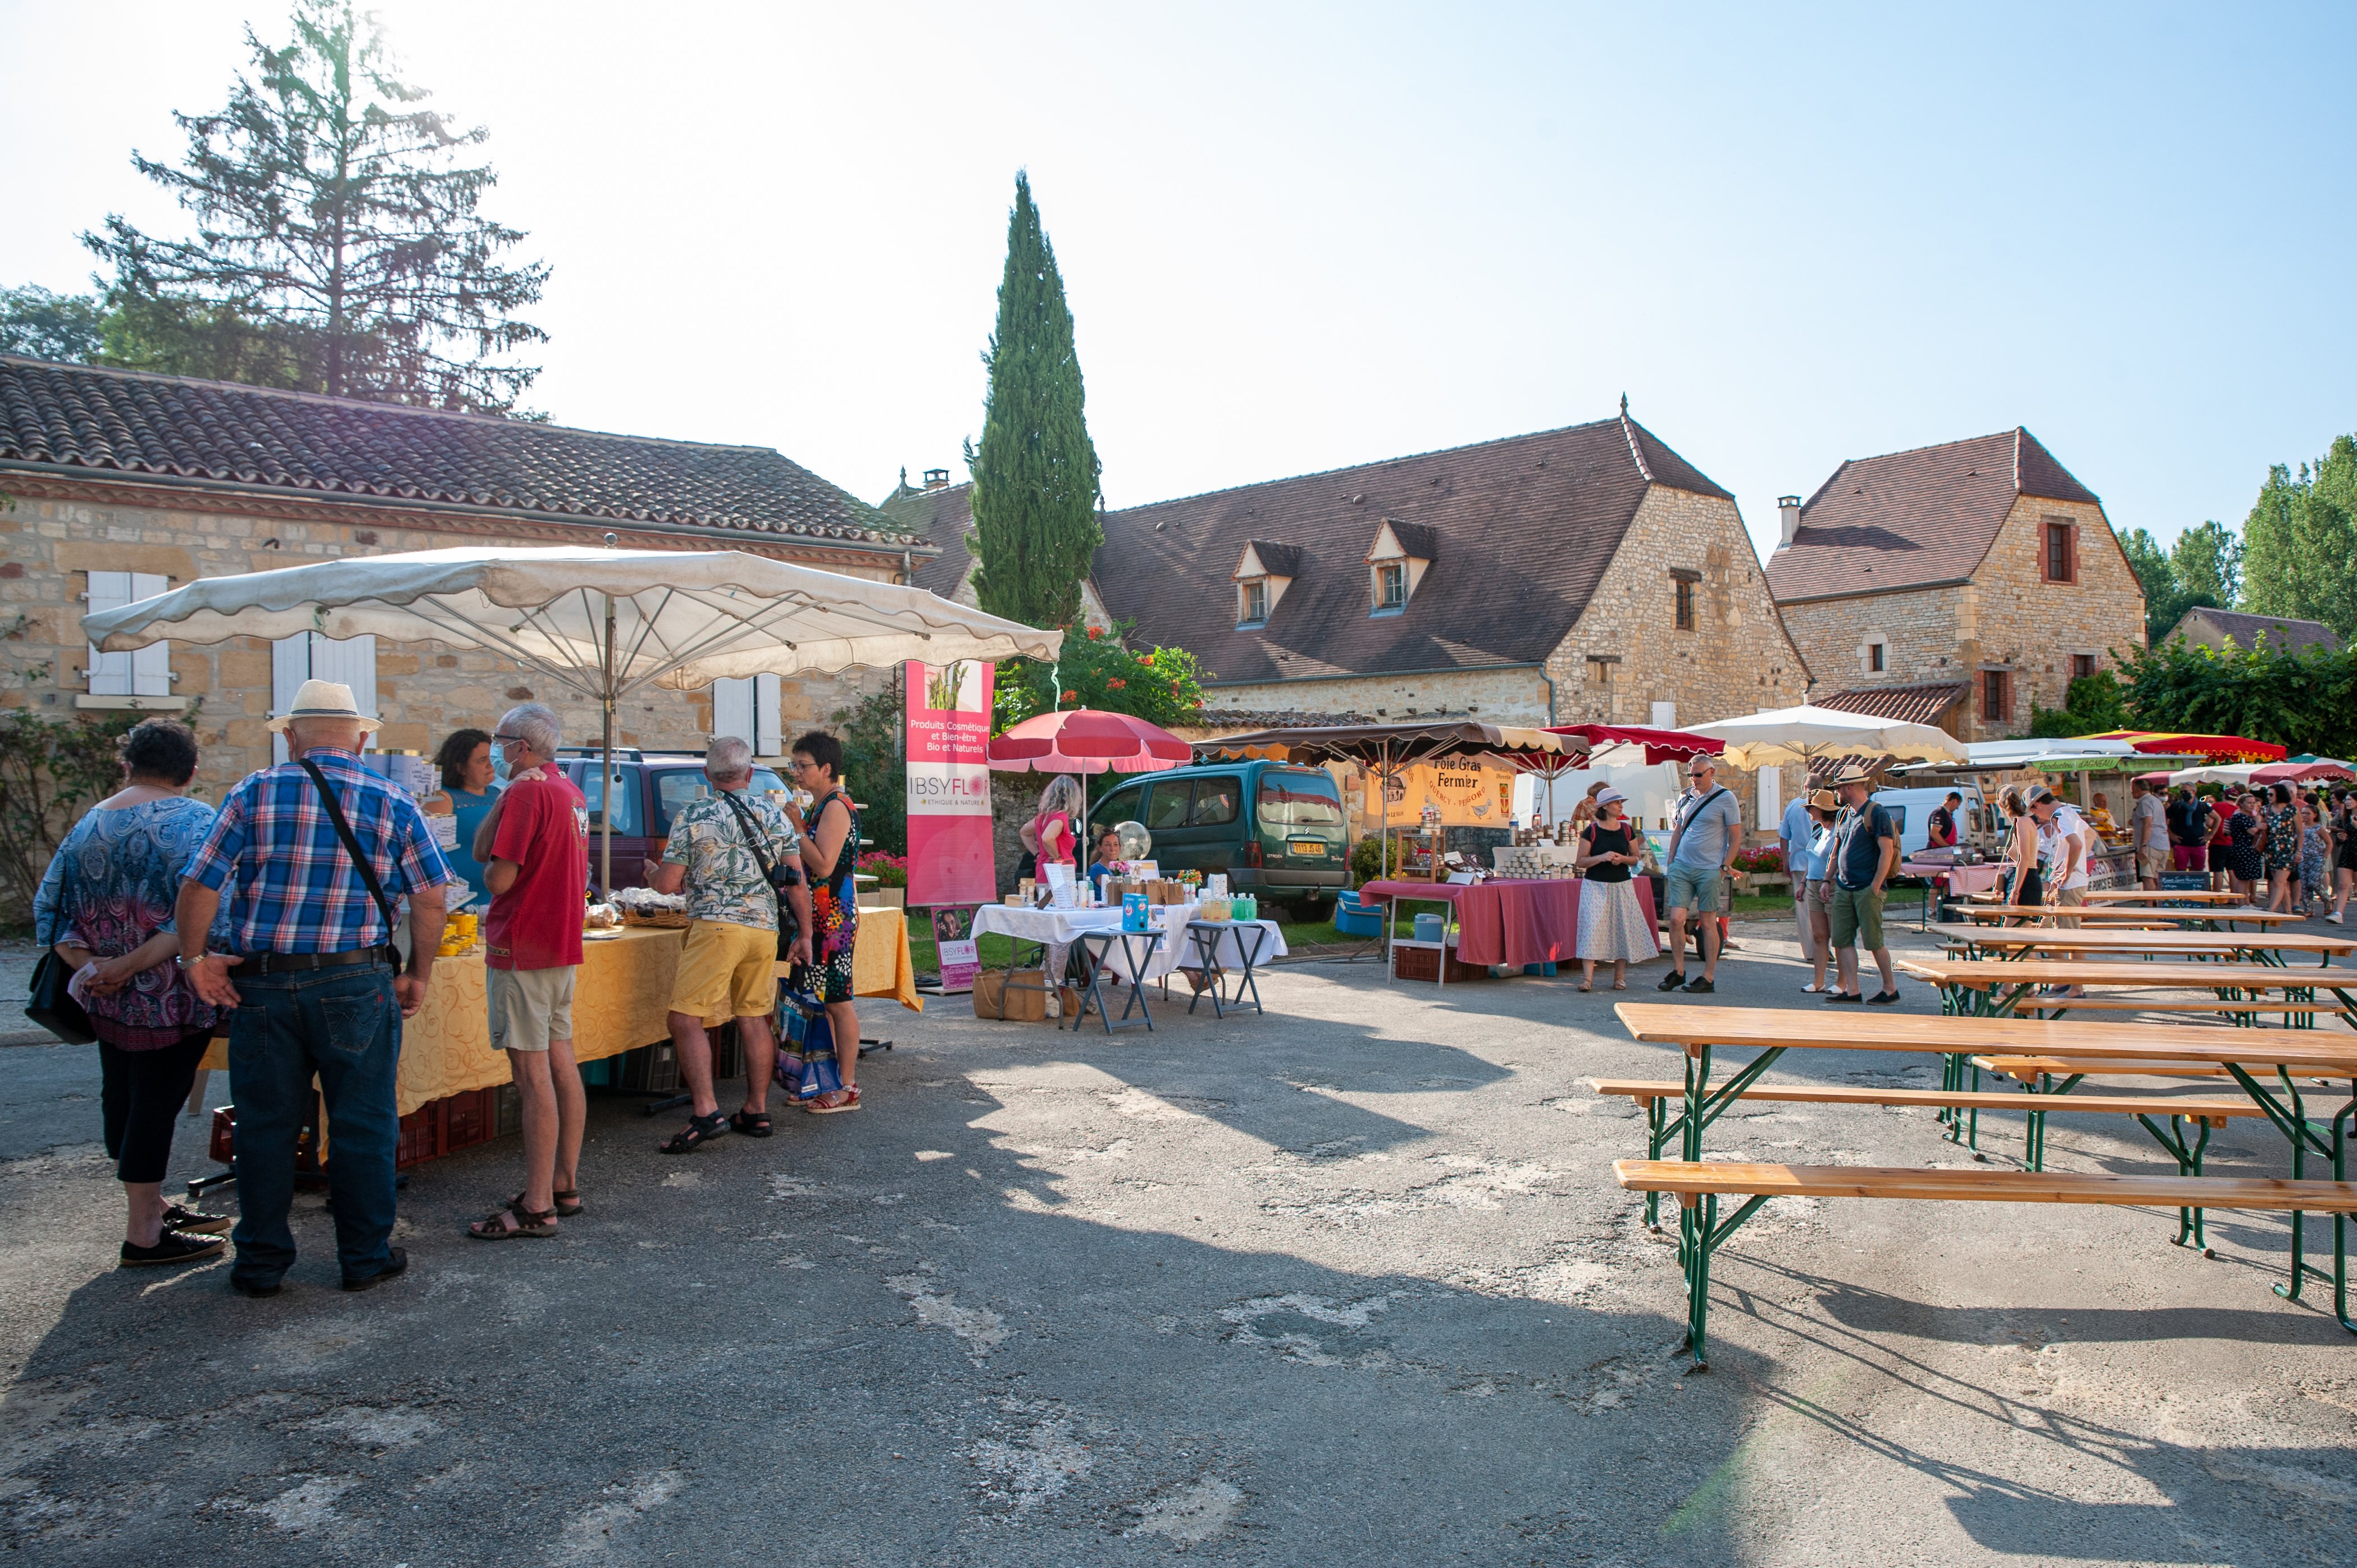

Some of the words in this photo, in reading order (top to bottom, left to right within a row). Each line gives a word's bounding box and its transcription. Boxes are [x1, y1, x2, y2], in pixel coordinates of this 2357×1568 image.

[911, 719, 945, 730] Produits
[942, 732, 977, 742] Bien-être
[927, 742, 940, 751] Bio
[953, 744, 983, 753] Naturels
[1459, 756, 1481, 772] Gras
[1437, 772, 1478, 788] Fermier
[1430, 781, 1451, 805] QUERCY
[1294, 844, 1307, 853] 7113
[1308, 844, 1314, 853] JS
